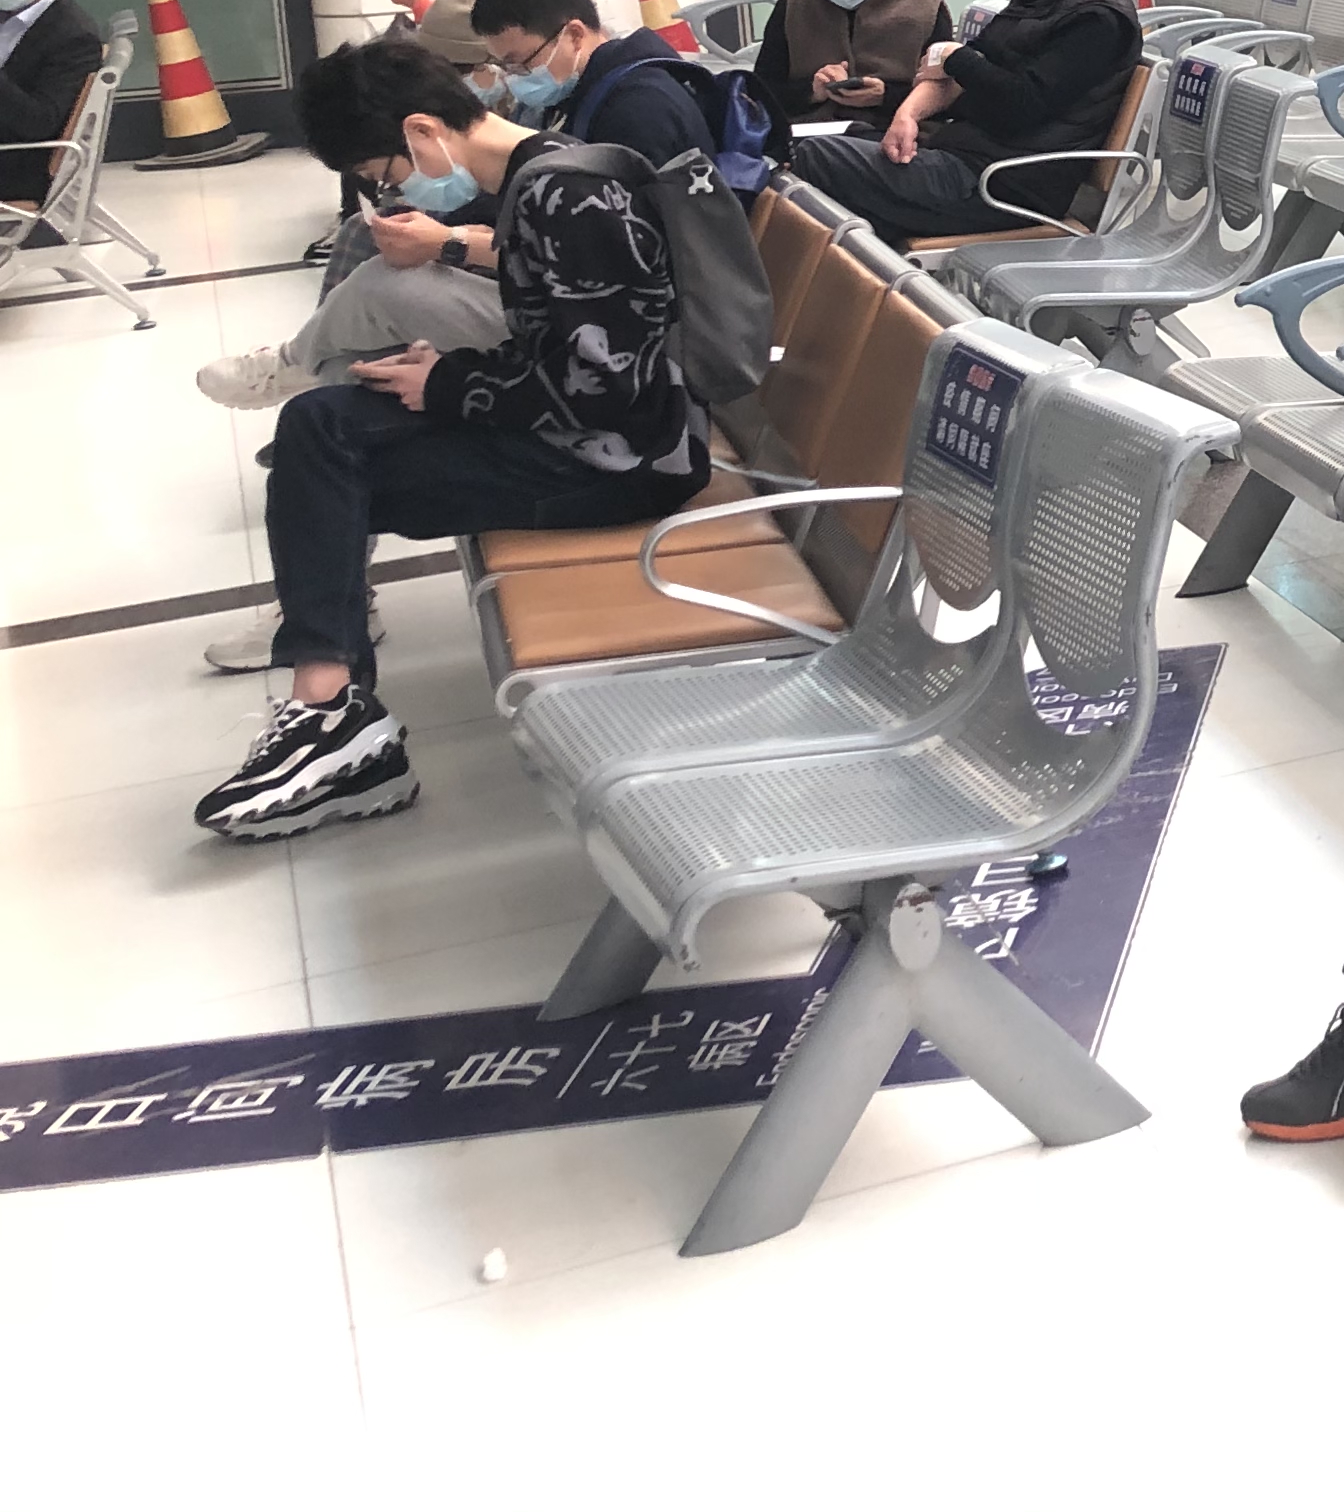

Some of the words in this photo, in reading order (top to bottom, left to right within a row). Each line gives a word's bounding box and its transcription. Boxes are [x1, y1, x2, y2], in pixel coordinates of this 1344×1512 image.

[591, 1010, 695, 1096] 六十七
[688, 1013, 773, 1071] 病区
